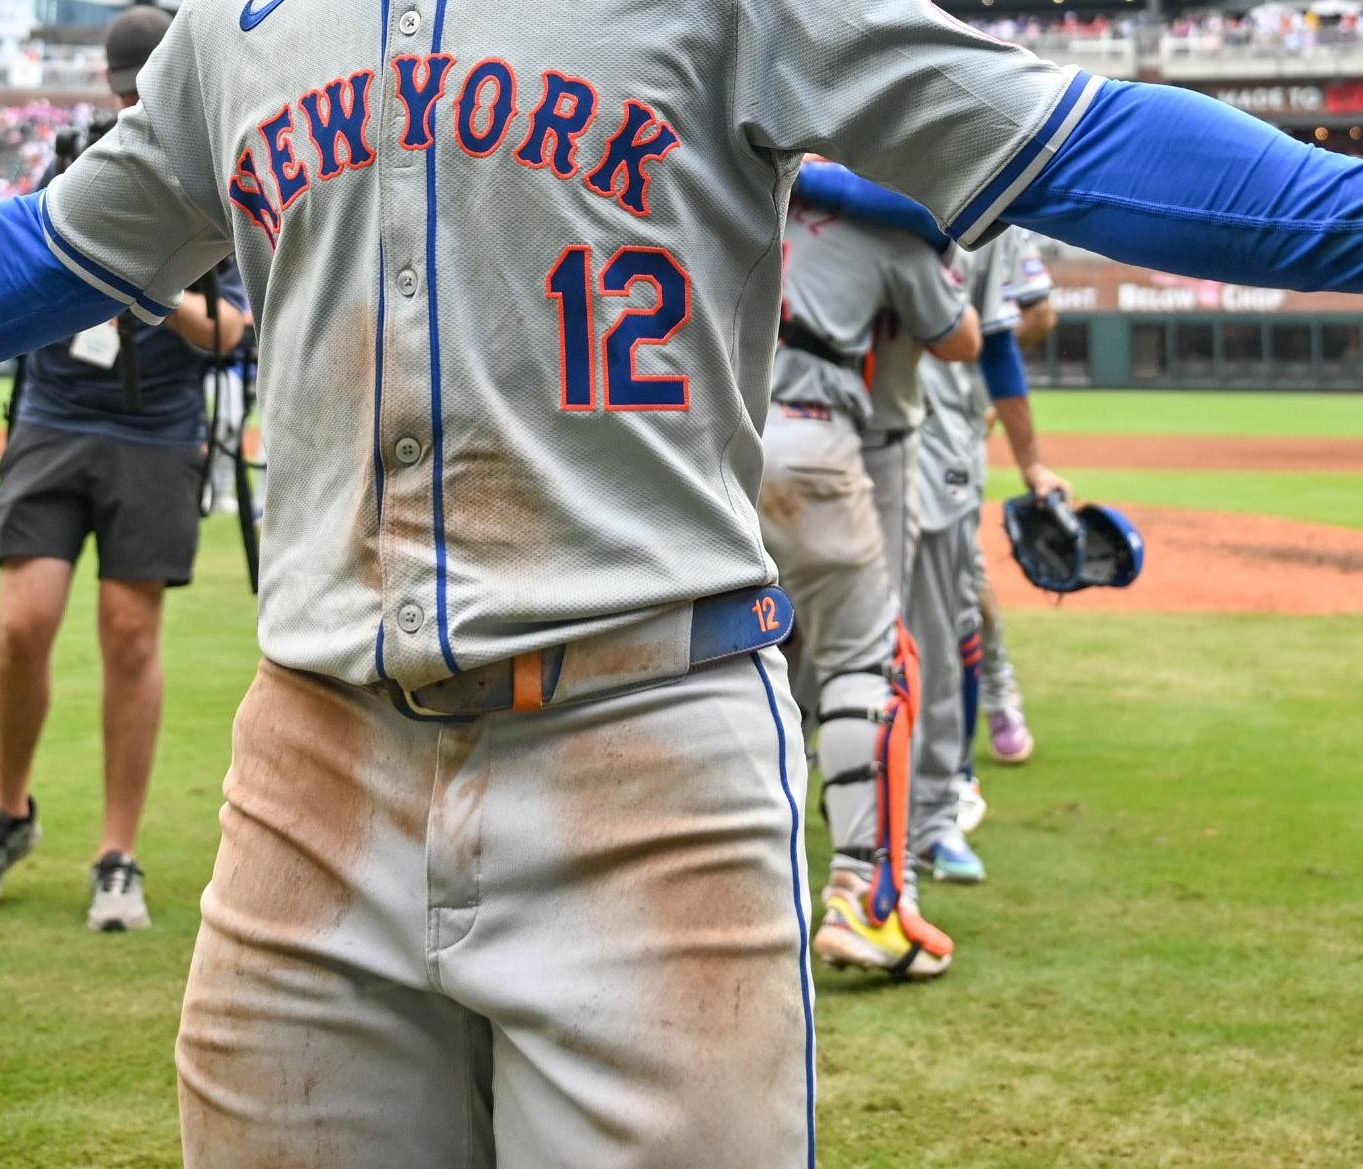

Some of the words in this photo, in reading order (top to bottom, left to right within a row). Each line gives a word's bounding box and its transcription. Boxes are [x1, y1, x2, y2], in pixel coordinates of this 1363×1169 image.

[227, 68, 378, 251] NEW
[391, 52, 681, 217] YORK
[545, 244, 692, 412] 12
[751, 596, 780, 632] 12
